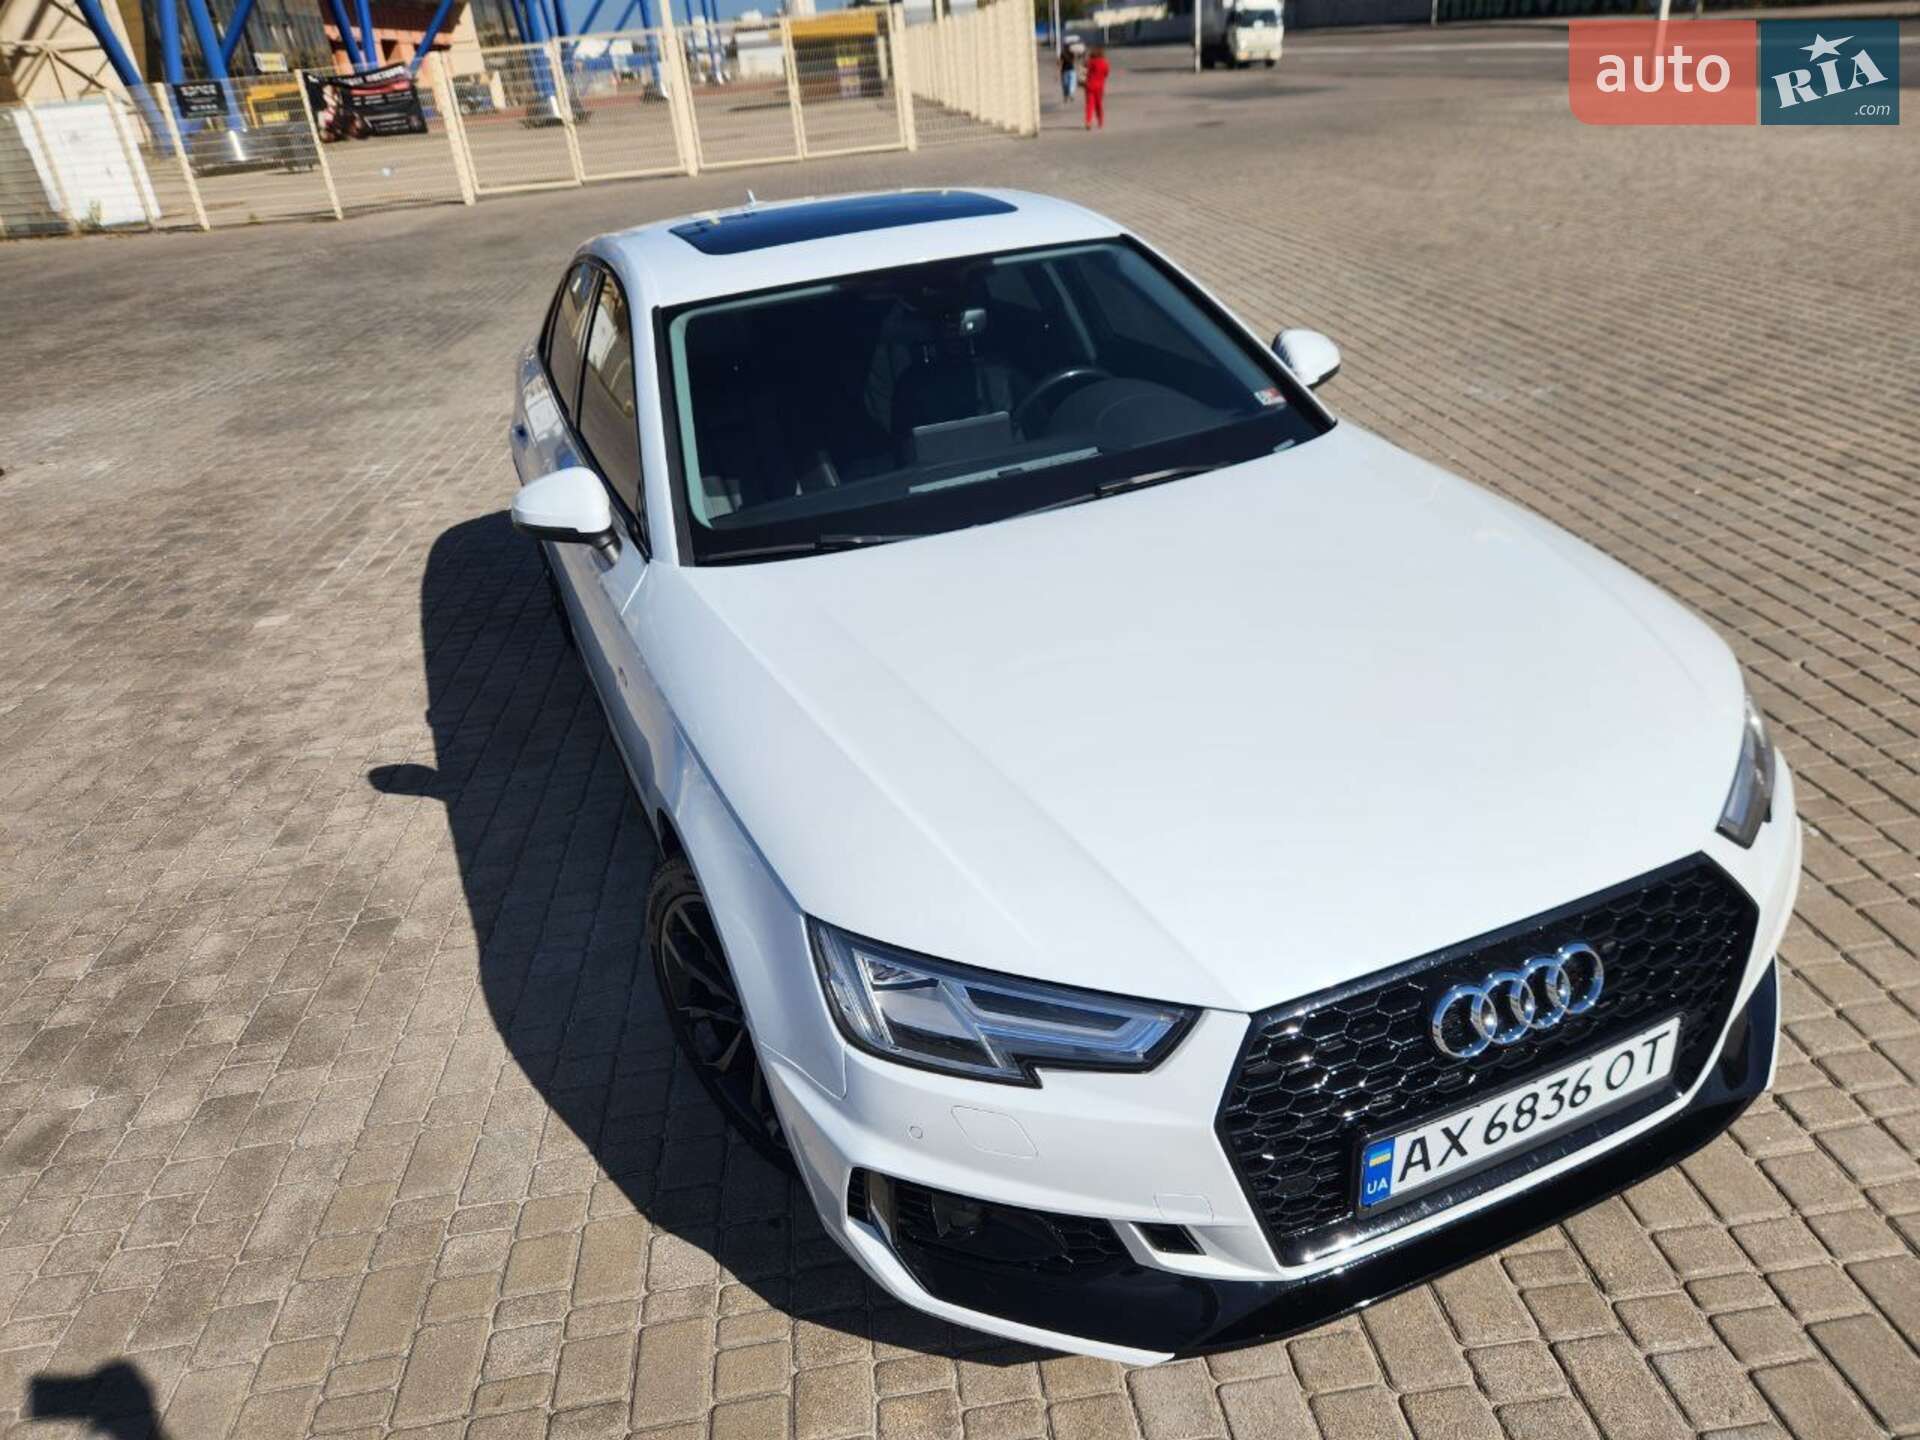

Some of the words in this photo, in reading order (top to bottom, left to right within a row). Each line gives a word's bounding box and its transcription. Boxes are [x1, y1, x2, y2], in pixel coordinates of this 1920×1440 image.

[1398, 1116, 1473, 1183] AX
[1483, 1067, 1592, 1146] 6836
[1605, 1031, 1670, 1091] OT
[1366, 1178, 1388, 1195] UA
